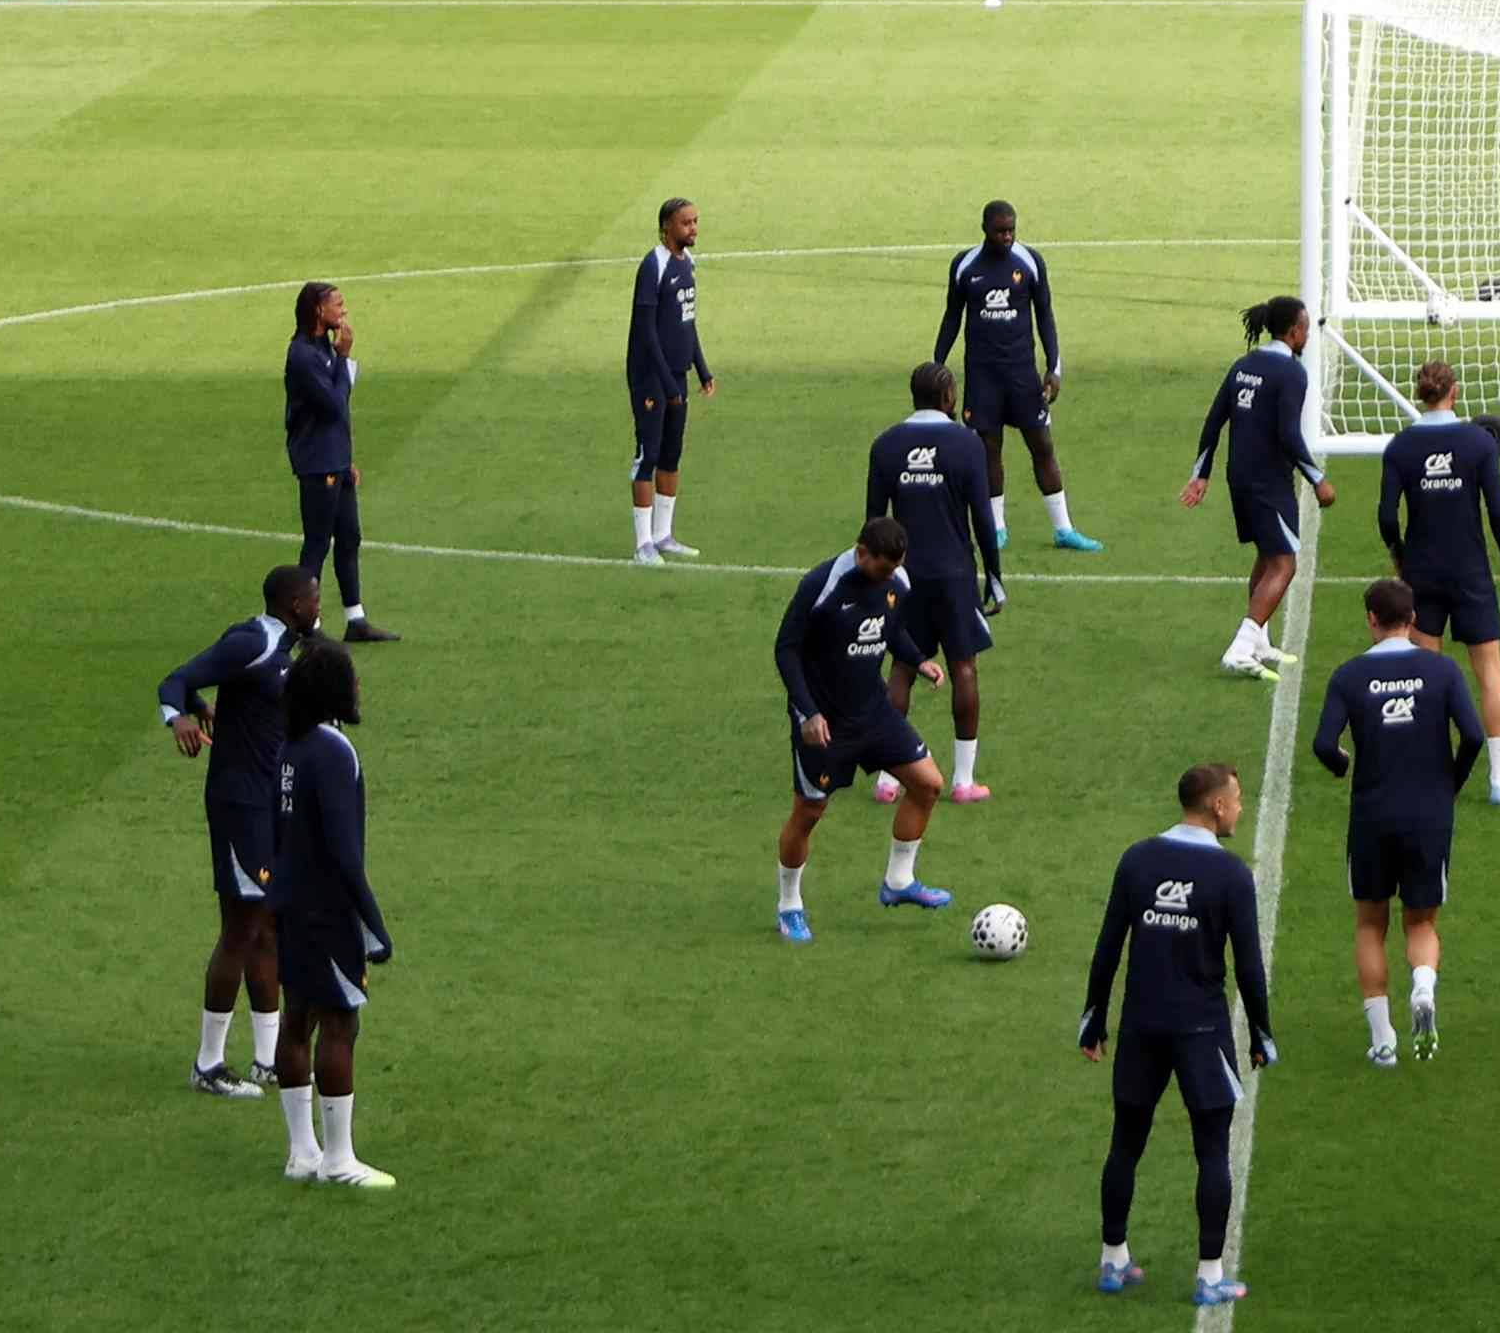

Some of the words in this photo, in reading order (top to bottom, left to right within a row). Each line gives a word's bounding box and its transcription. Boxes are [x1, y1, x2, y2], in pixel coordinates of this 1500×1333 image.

[980, 309, 1018, 320] Orange
[1236, 370, 1263, 386] Orange
[900, 471, 944, 485] Orange
[1420, 478, 1463, 490] Orange
[1369, 678, 1424, 694] Orange
[1143, 909, 1198, 931] Orange
